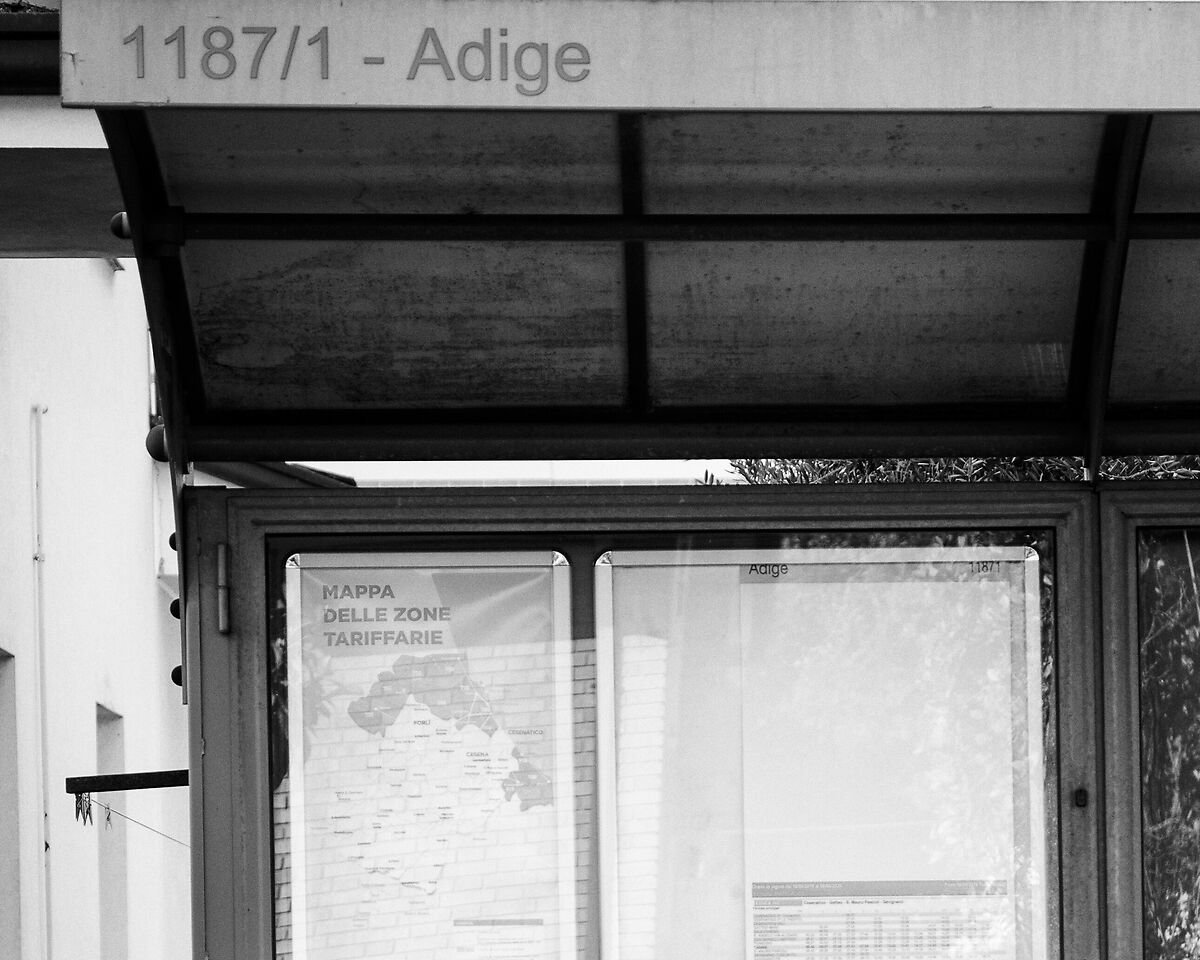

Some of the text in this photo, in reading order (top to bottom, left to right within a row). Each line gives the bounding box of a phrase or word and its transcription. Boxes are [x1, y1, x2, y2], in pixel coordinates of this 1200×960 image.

[123, 25, 331, 80] 1187/1
[407, 26, 591, 96] Adige
[748, 563, 789, 577] Adige
[322, 584, 396, 600] MAPPA
[323, 606, 451, 623] DELLE ZONE
[323, 630, 443, 646] TARIFFARIE
